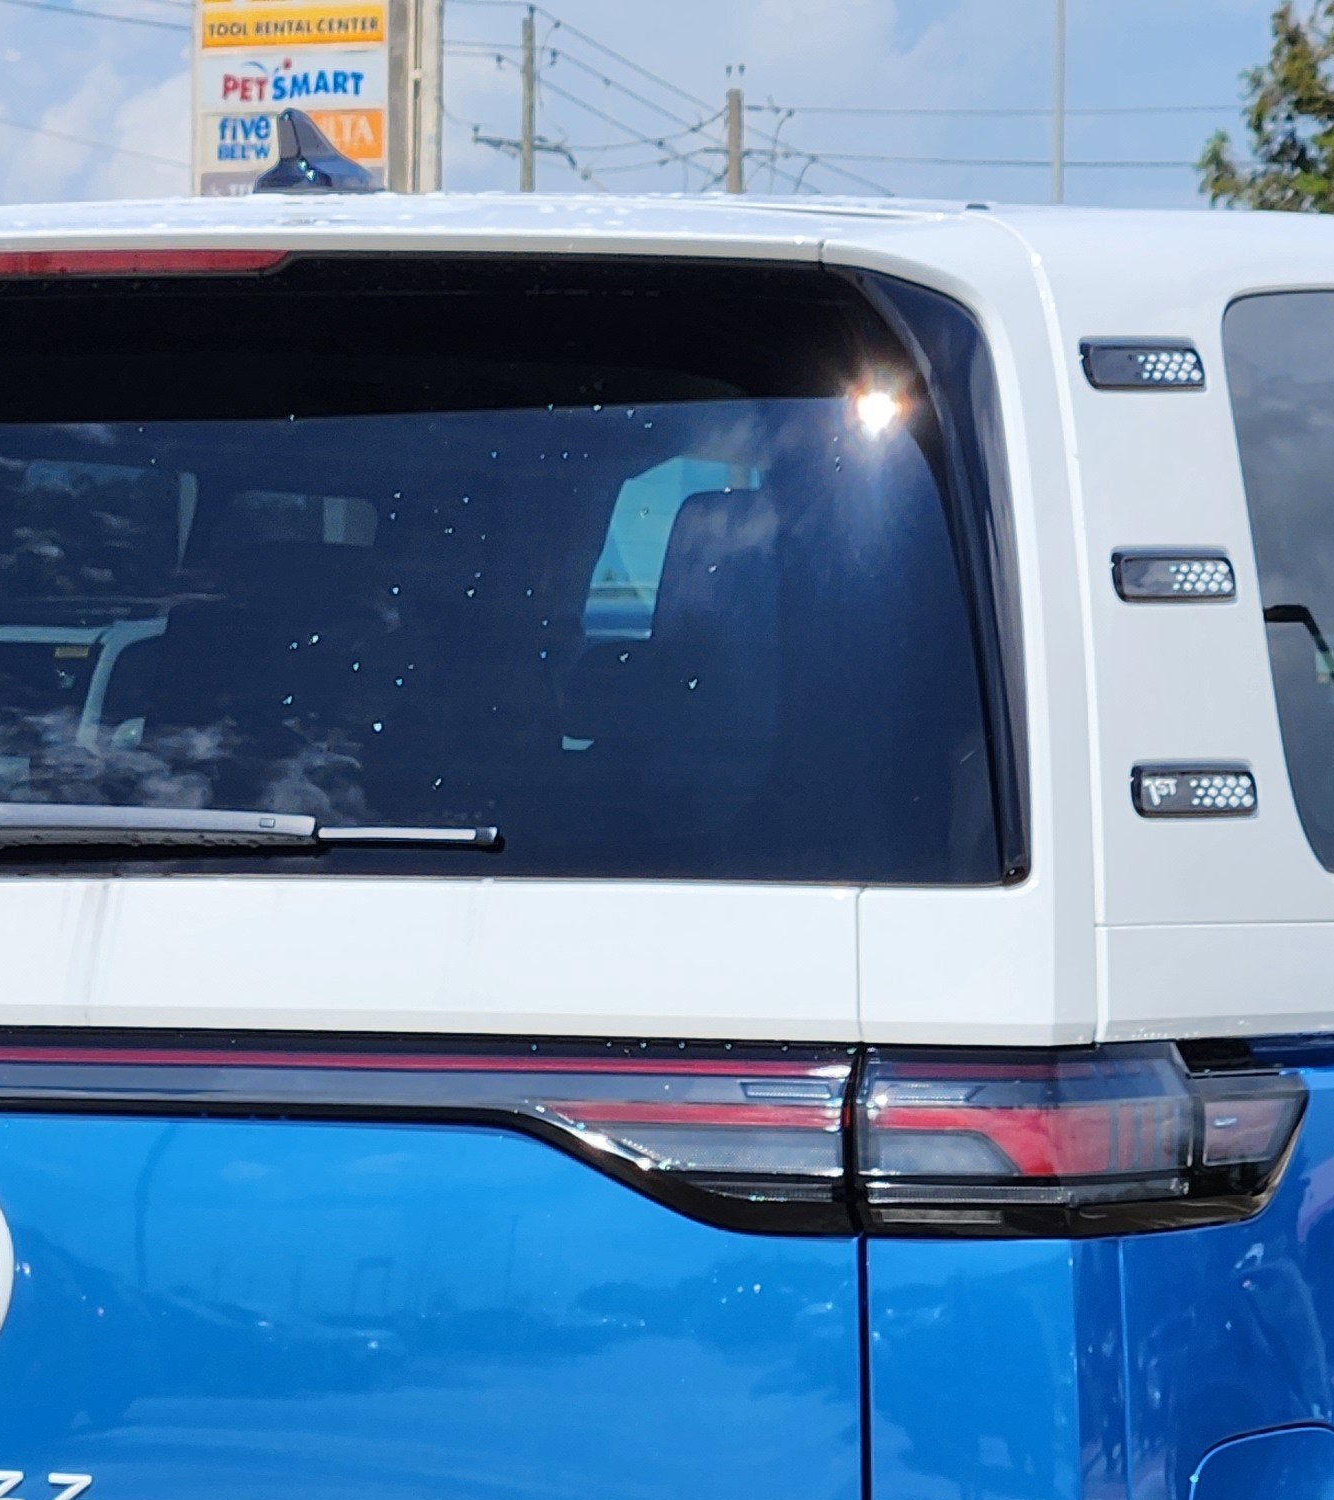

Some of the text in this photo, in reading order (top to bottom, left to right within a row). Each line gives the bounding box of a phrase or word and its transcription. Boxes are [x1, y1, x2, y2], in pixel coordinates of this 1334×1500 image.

[209, 16, 379, 38] TOOL RENTAL CENTER
